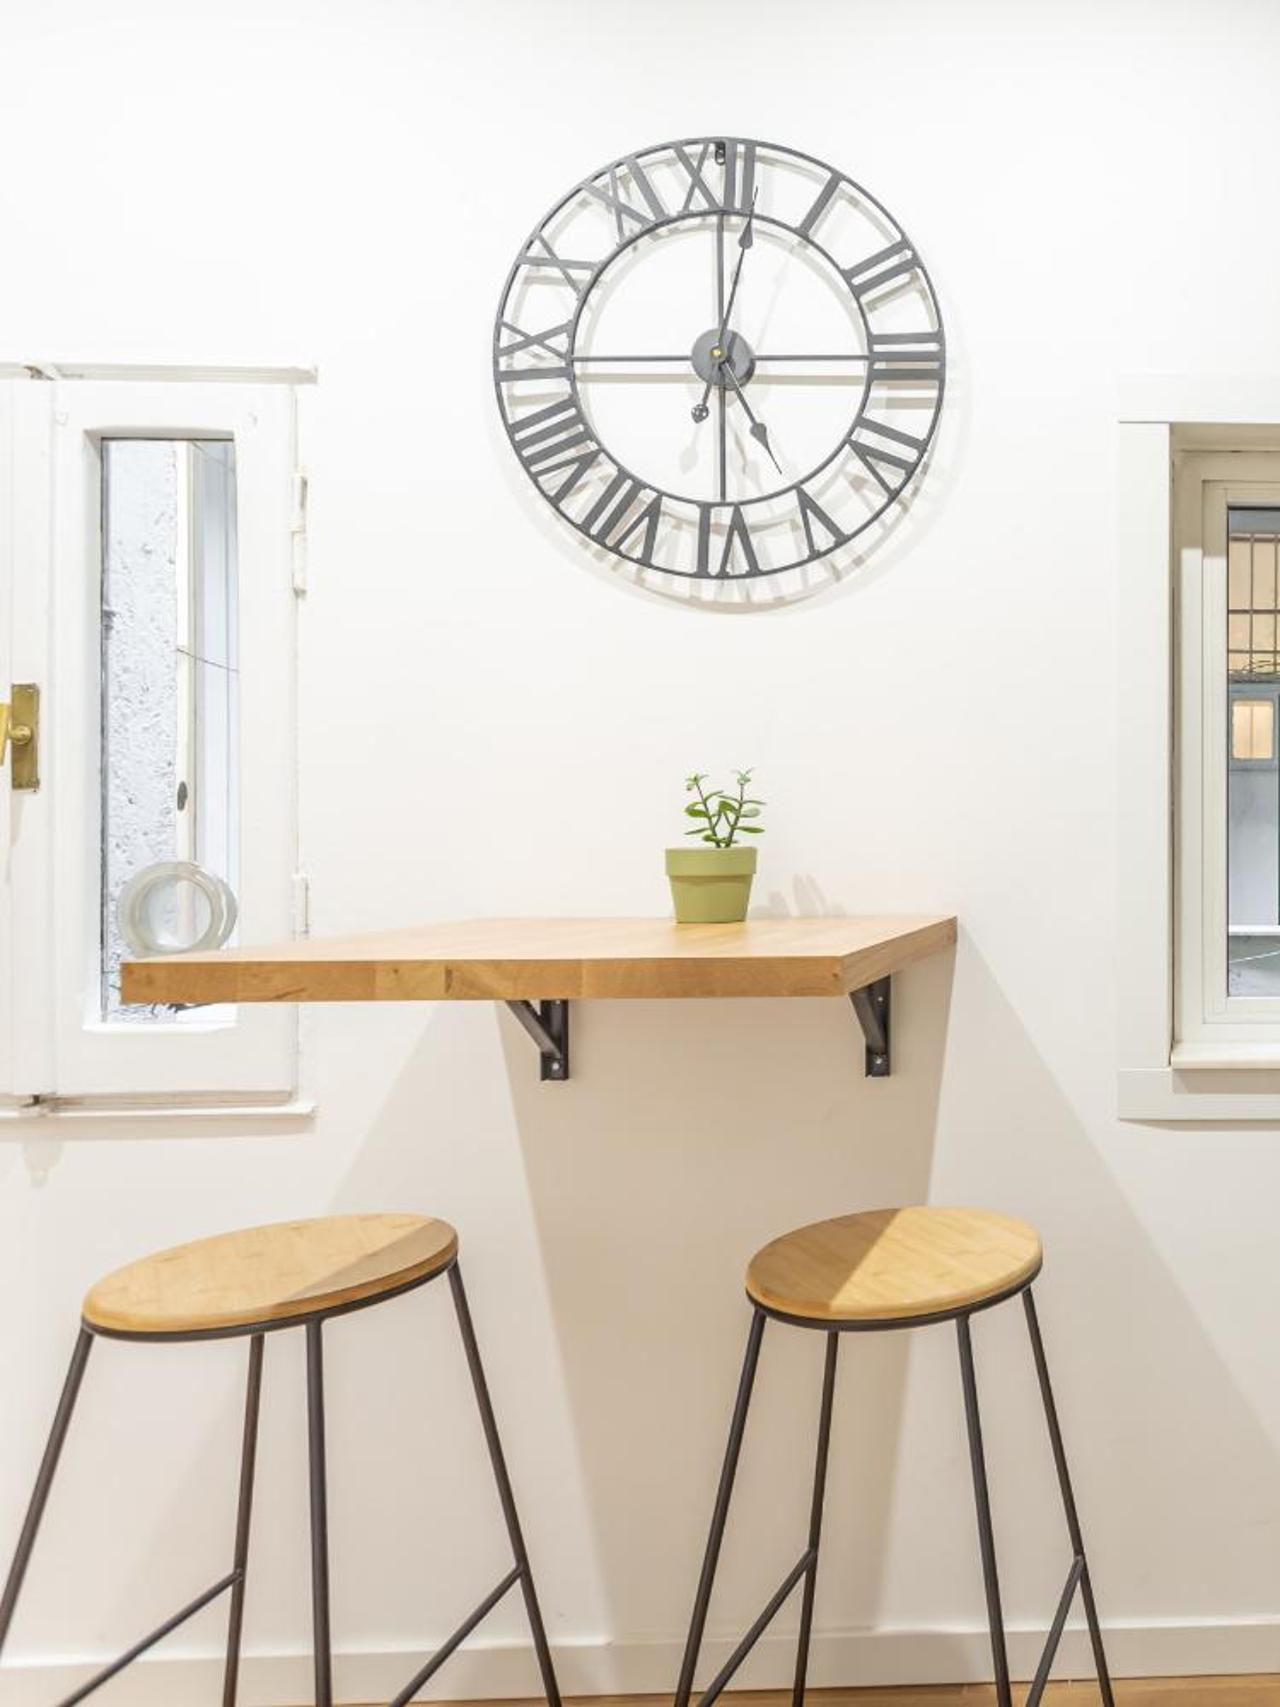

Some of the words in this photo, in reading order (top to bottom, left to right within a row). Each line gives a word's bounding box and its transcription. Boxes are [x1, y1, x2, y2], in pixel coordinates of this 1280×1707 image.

[580, 156, 670, 246] XI
[673, 142, 757, 213] XII
[521, 233, 597, 300] X
[845, 240, 922, 296] II
[496, 321, 573, 381] IX
[870, 333, 944, 381] III
[511, 396, 600, 503] VIII
[847, 417, 928, 495] IV
[582, 469, 662, 563] VII
[695, 503, 760, 576] VI
[796, 487, 848, 557] V
